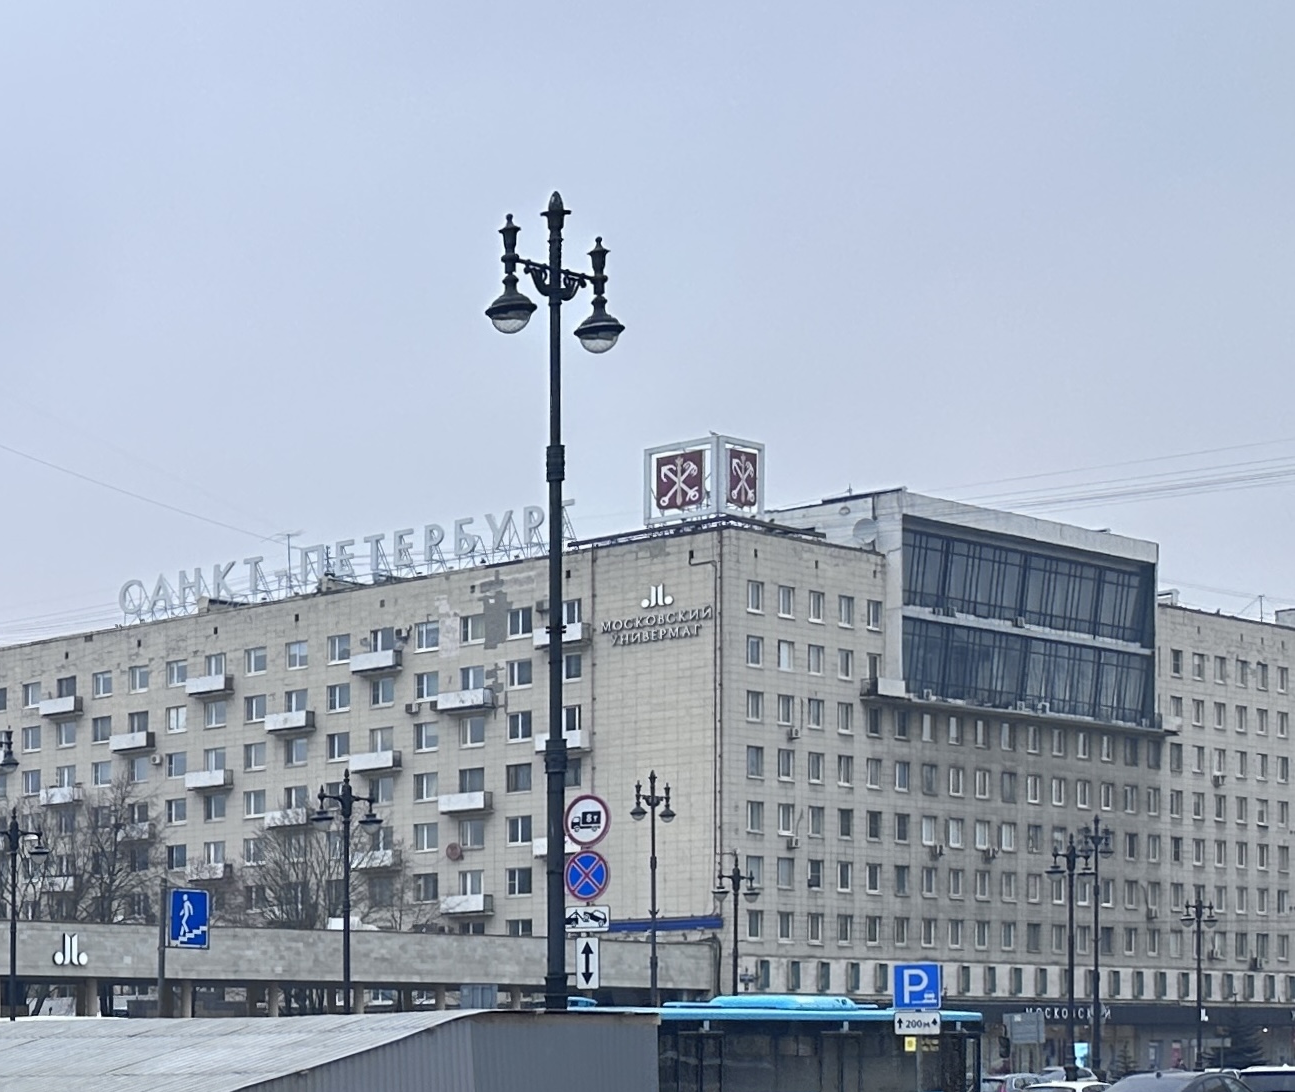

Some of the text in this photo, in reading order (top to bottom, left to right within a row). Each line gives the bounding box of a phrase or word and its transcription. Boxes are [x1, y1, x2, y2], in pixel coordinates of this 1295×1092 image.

[118, 498, 575, 615] САНКТ-ПЕТЕРБУР
[601, 605, 712, 634] МОСКОВСКИЙ
[612, 624, 702, 647] УНИВЕРМАГ
[903, 968, 929, 1004] P
